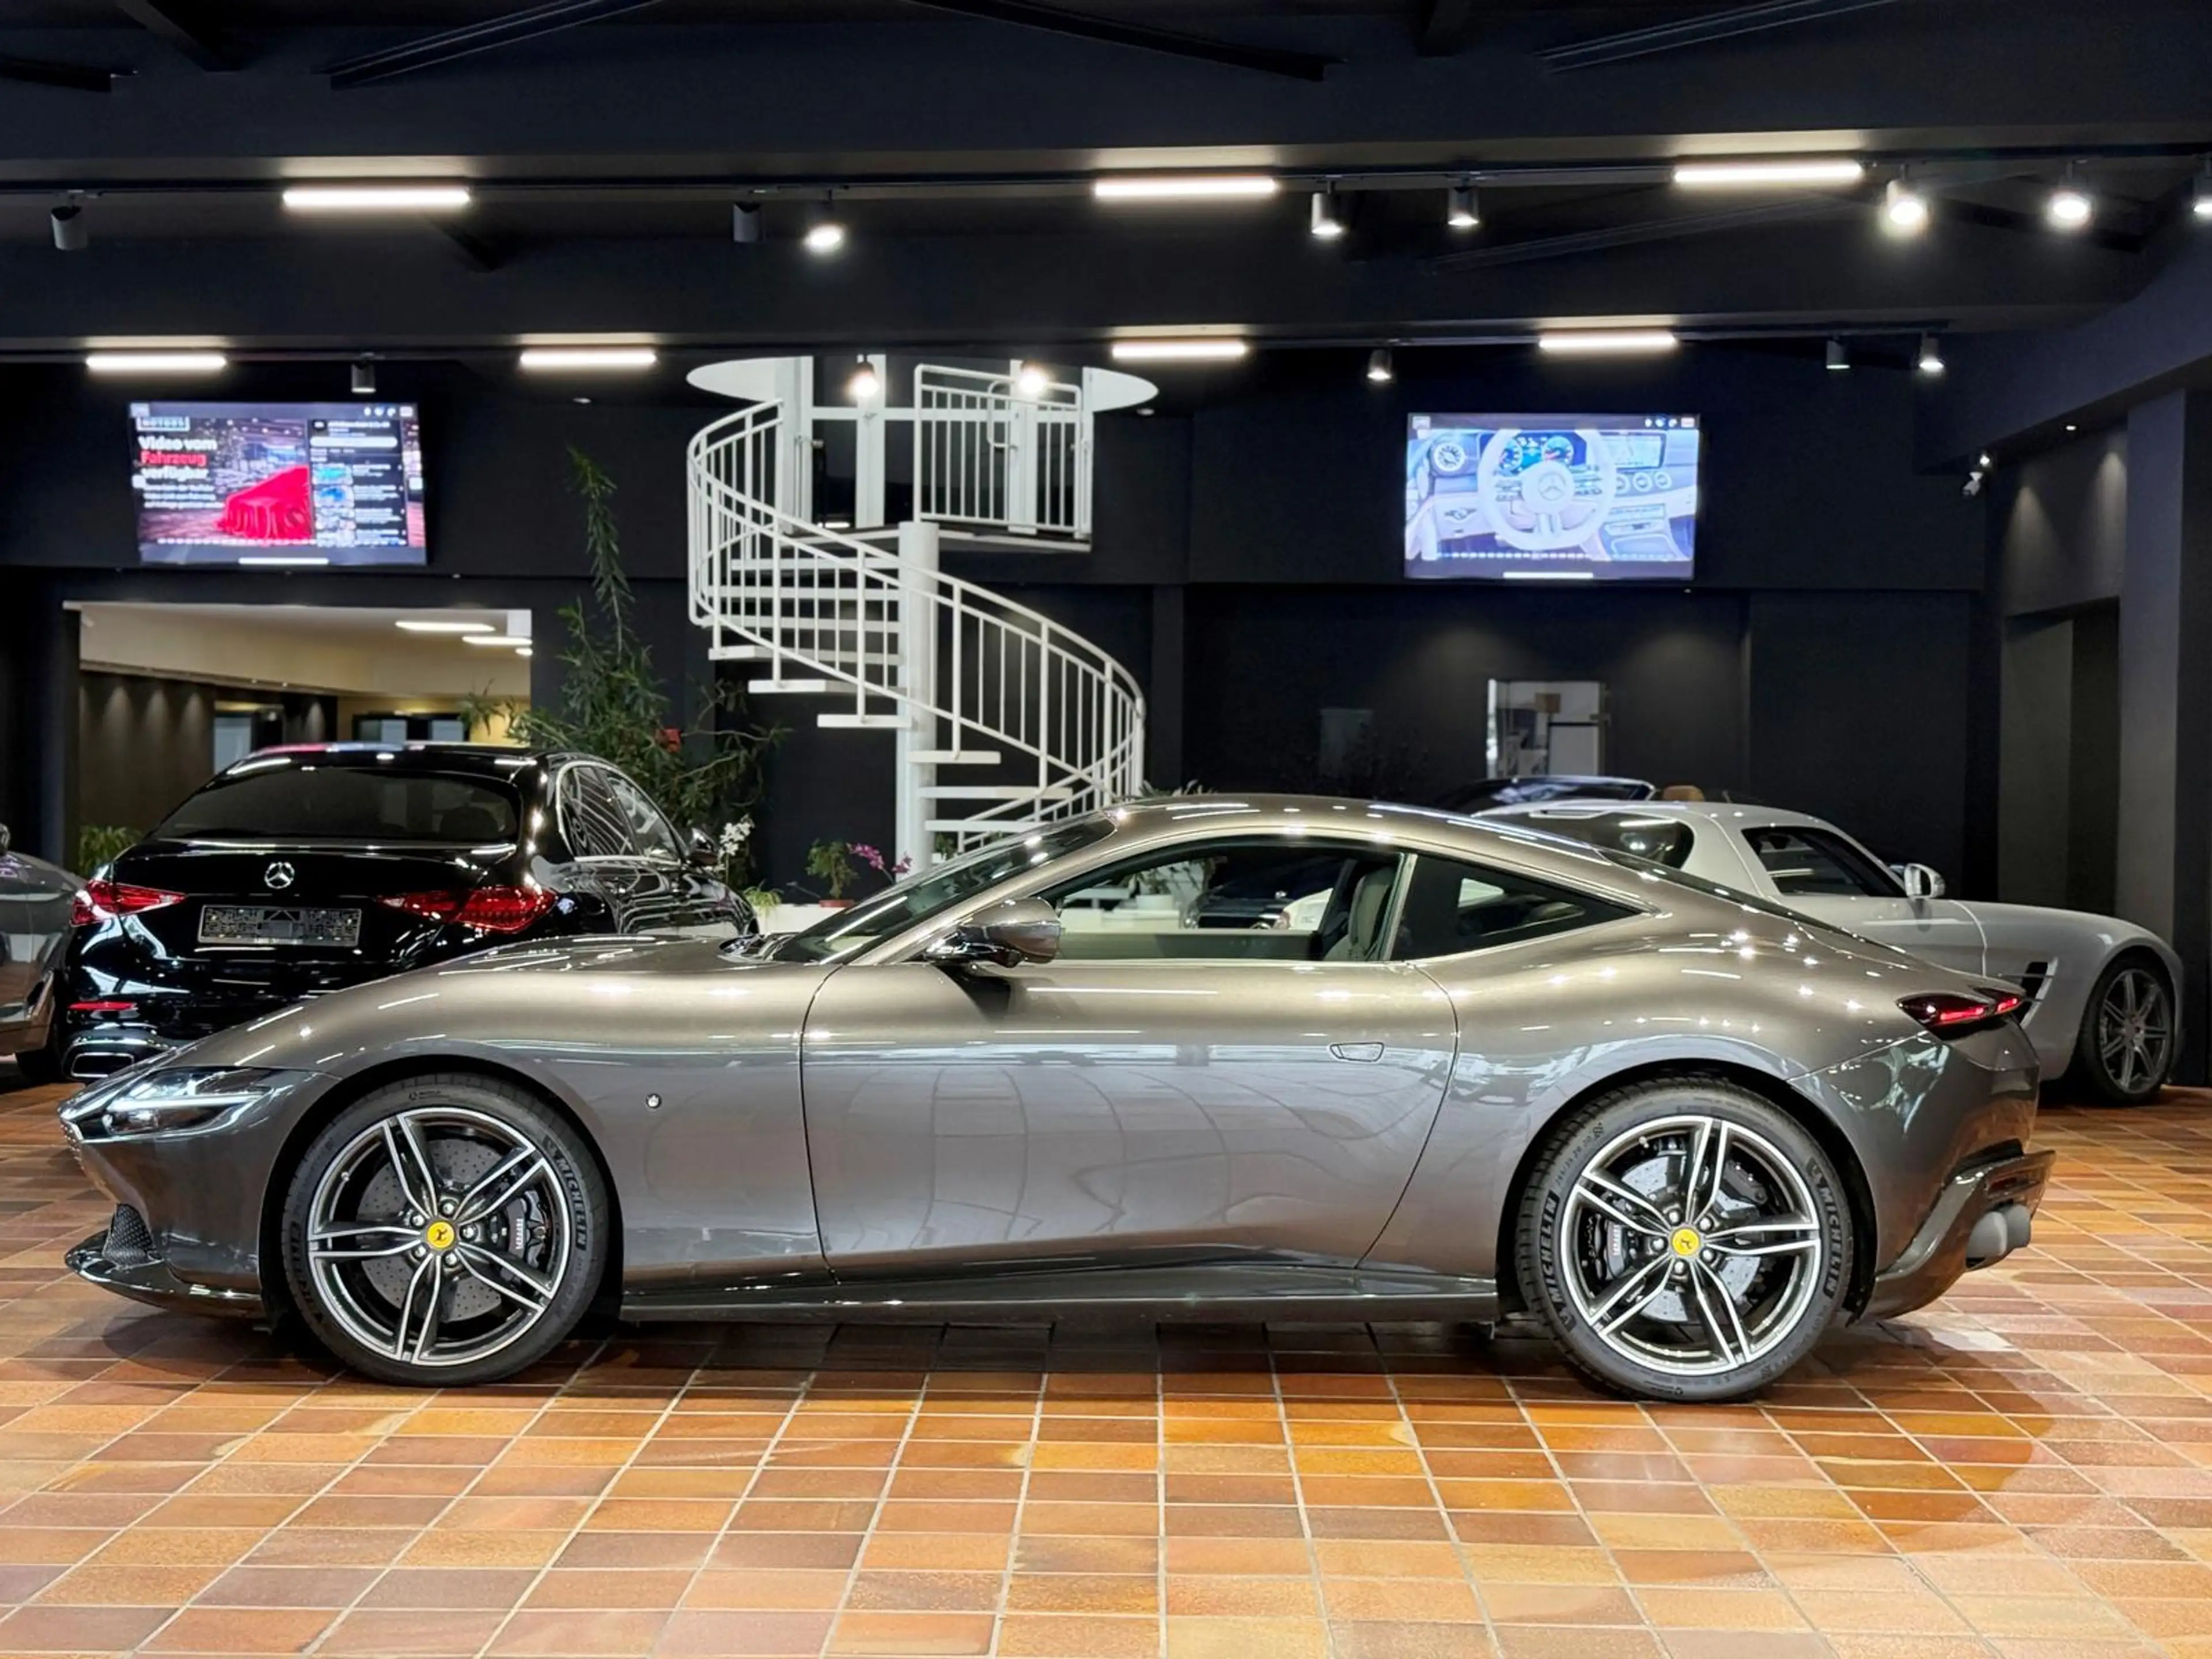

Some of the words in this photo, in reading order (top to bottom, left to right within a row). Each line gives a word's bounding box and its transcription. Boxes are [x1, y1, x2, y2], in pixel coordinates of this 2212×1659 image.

[137, 435, 183, 451] Video
[183, 438, 218, 450] vom
[141, 450, 207, 467] Fahrzeug
[554, 1157, 588, 1248] MICHELIN
[1819, 1185, 1842, 1294] MICHELIN
[1540, 1195, 1563, 1304] MICHELIN
